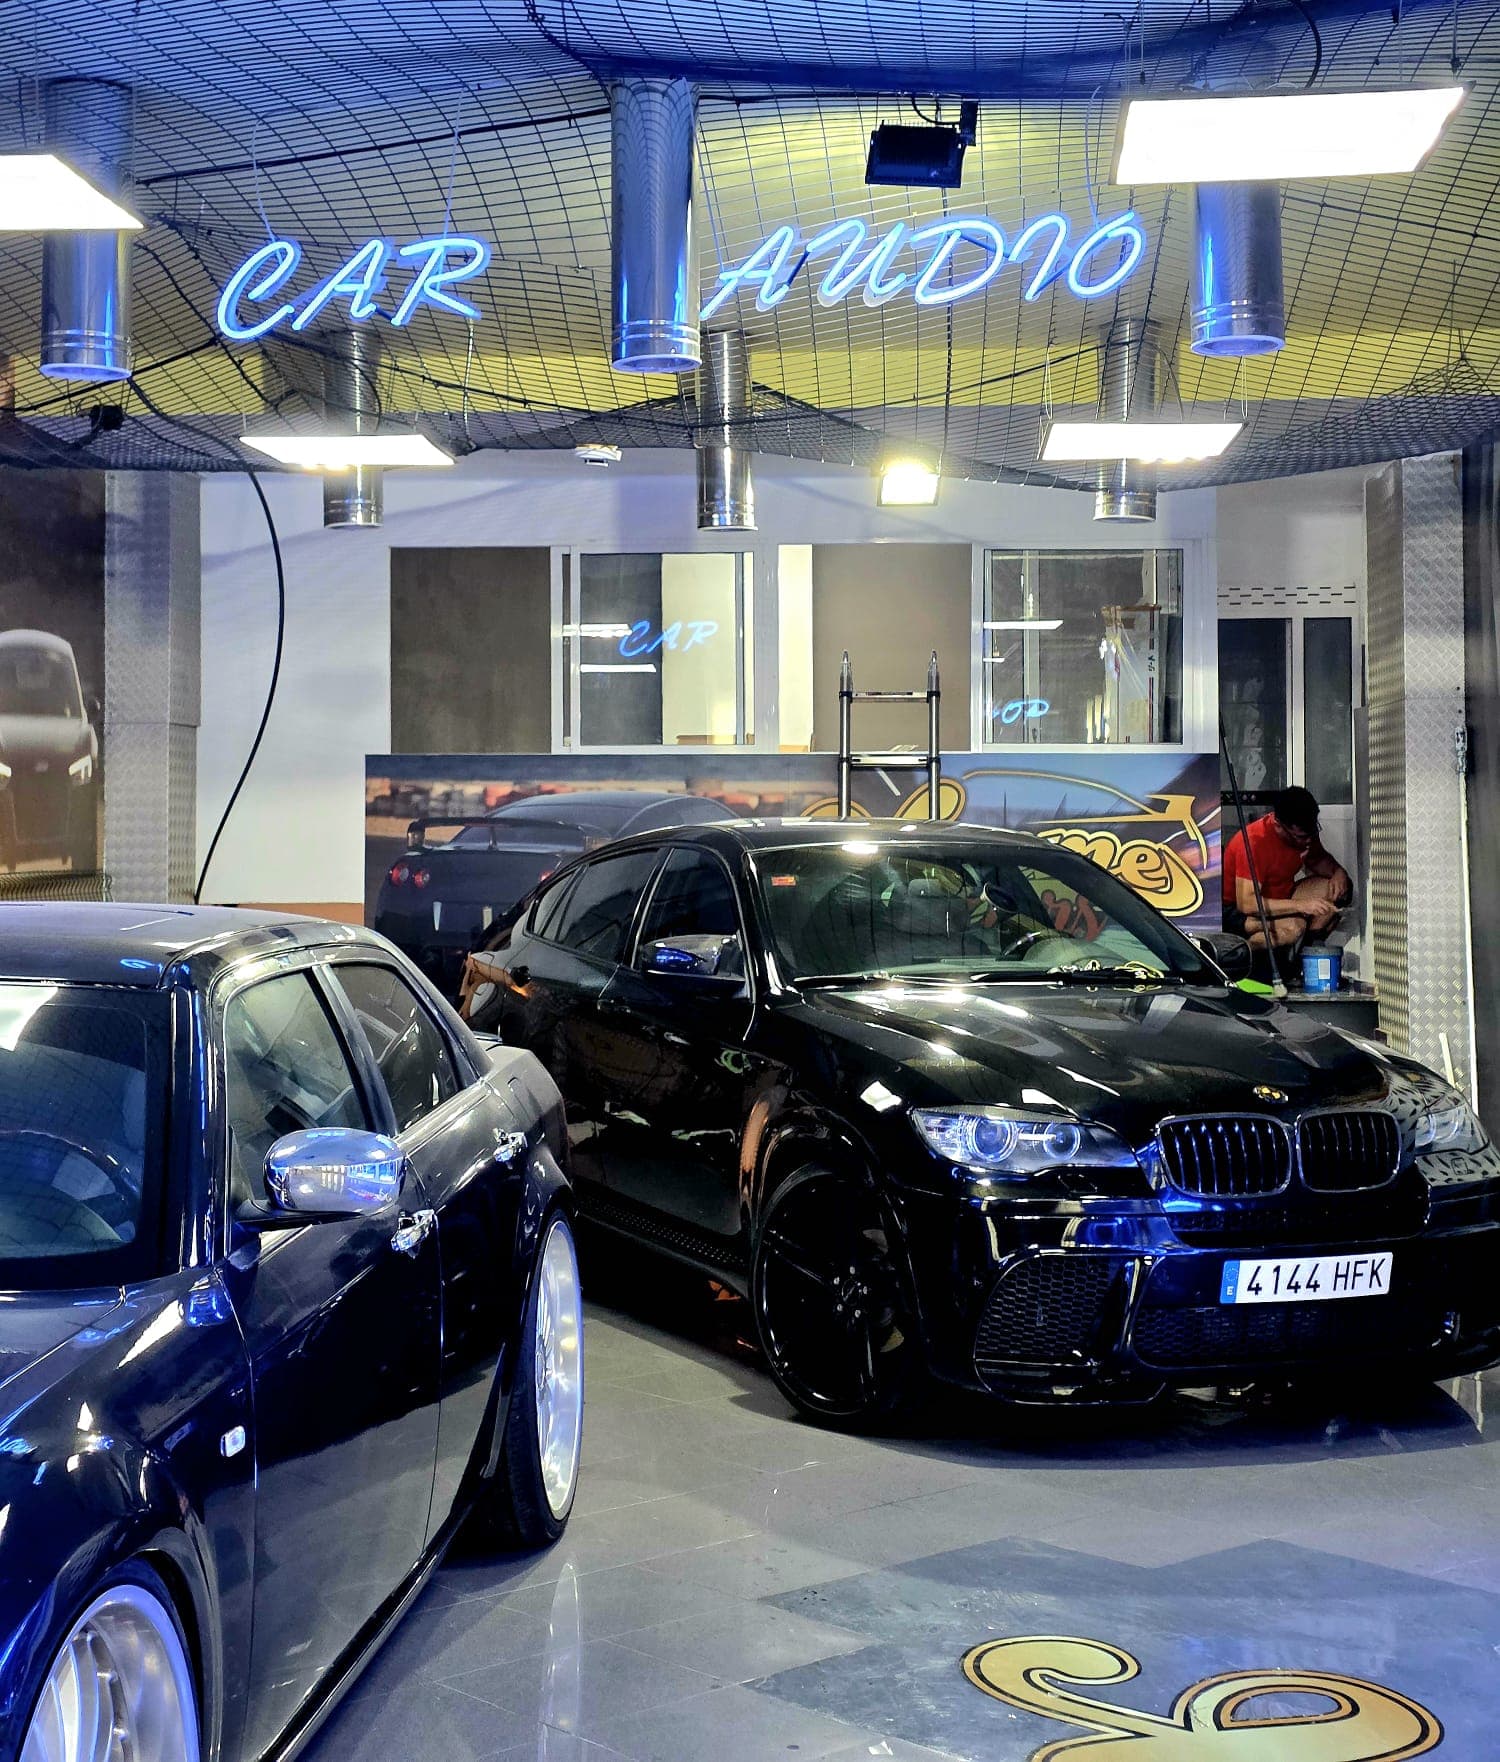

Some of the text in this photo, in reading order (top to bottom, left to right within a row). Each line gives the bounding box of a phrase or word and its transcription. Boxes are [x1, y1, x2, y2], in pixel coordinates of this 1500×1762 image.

[217, 209, 1146, 341] CAR AUDIO
[1226, 1257, 1387, 1296] E 4144 HFK
